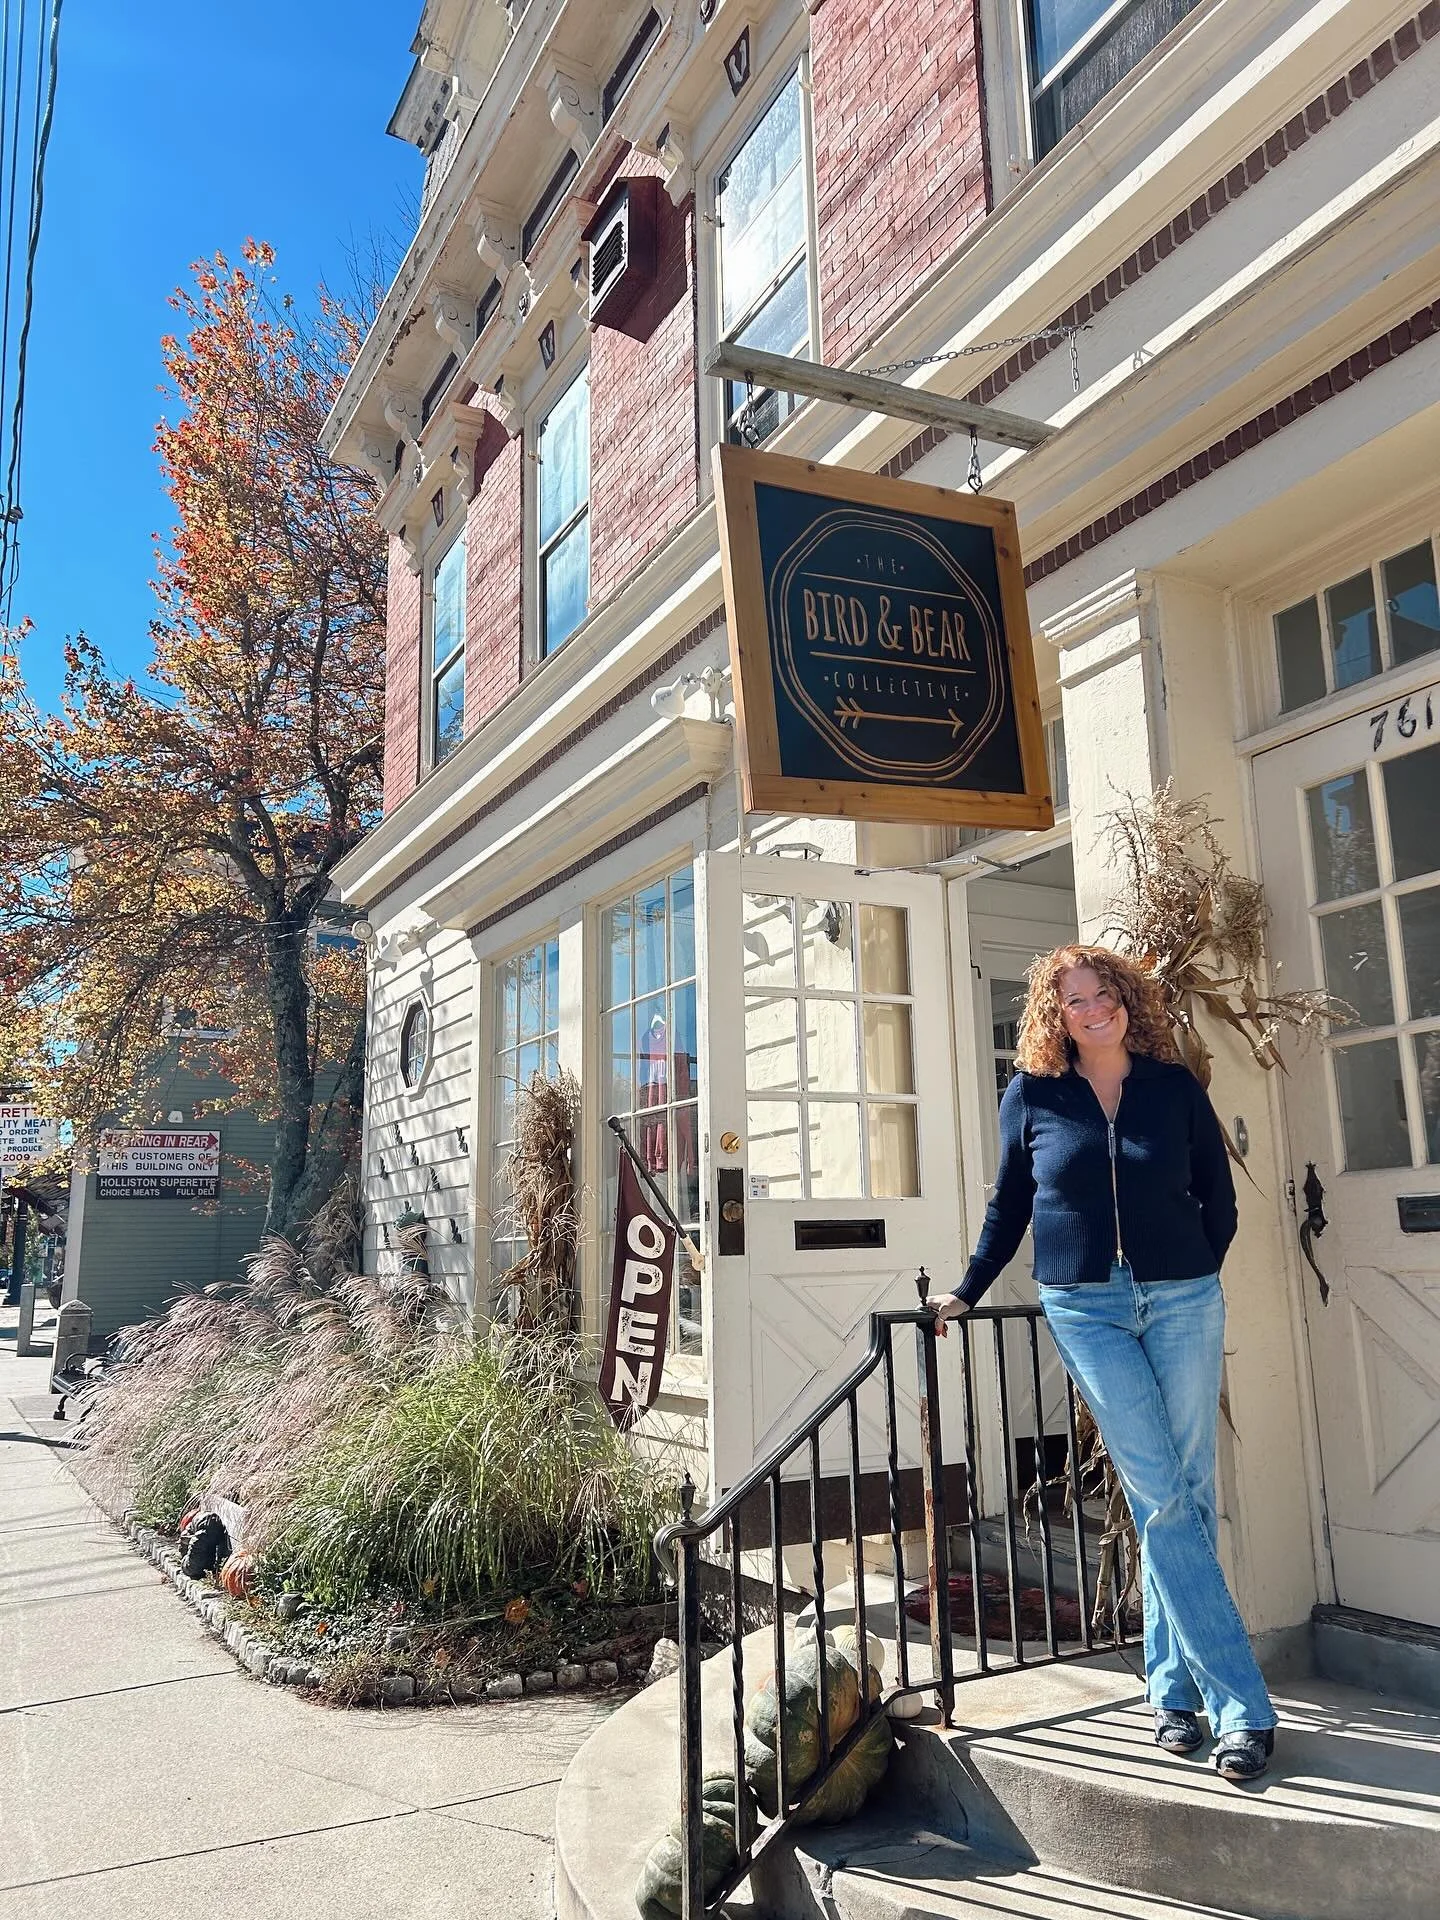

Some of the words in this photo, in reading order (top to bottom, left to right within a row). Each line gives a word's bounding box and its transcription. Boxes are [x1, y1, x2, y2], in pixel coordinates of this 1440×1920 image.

[862, 554, 897, 575] THE
[803, 588, 869, 647] BIRD
[877, 595, 904, 650] &
[909, 604, 972, 662] BEAR
[833, 671, 961, 702] COLLECTIVE
[1369, 690, 1434, 752] 761
[8, 1128, 40, 1136] ORDER
[163, 1135, 176, 1147] IN
[179, 1135, 209, 1147] REAR
[131, 1152, 195, 1160] CUSTOMERS
[198, 1152, 212, 1160] OF
[135, 1162, 183, 1171] BUILDING
[187, 1162, 214, 1171] ONLY
[100, 1178, 157, 1187] HOLLISTON
[160, 1178, 217, 1187] SUPERETTE
[100, 1188, 131, 1196] CHOICE
[132, 1188, 160, 1196] MEATS
[176, 1188, 195, 1196] FULL
[198, 1188, 215, 1196] DELI
[609, 1214, 666, 1407] OPEN
